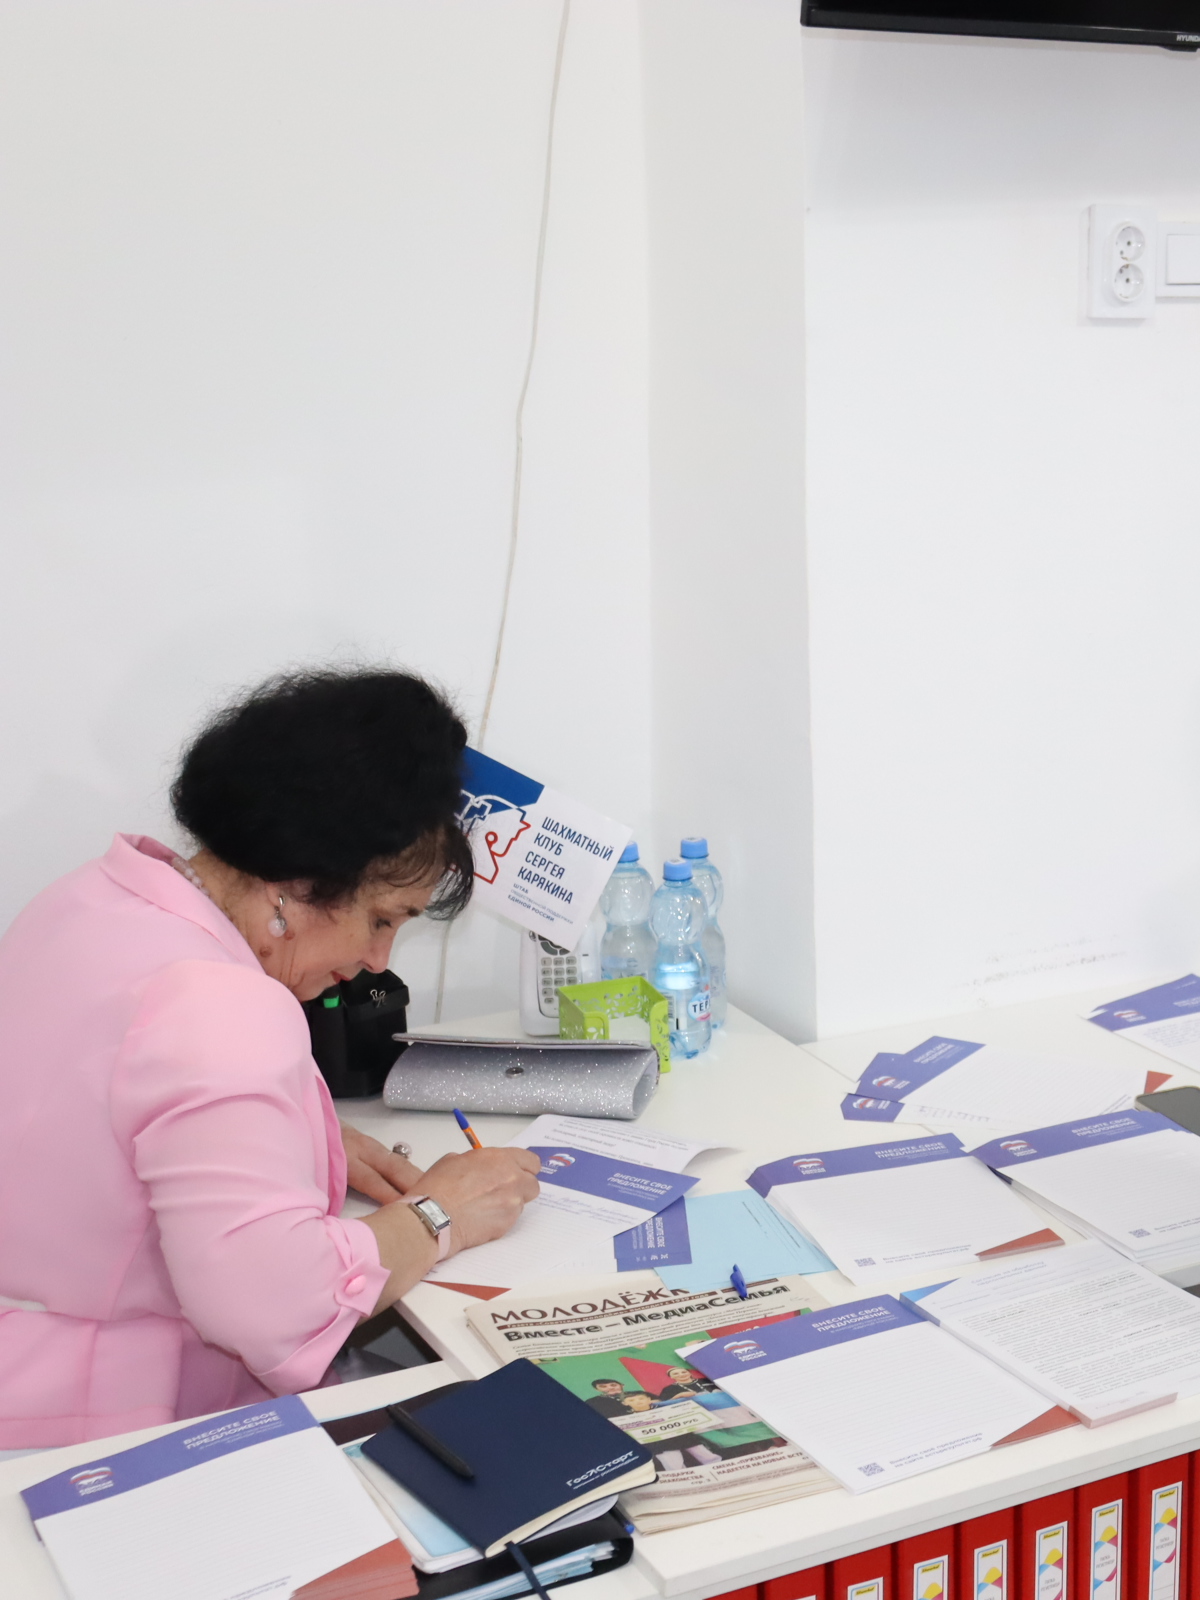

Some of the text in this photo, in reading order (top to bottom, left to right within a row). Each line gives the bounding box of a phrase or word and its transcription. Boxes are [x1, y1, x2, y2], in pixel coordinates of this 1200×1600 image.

[534, 832, 564, 856] КЛУБ
[541, 816, 614, 861] ШАХМАТНЫЙ
[525, 850, 566, 880] СЕРГЕЯ
[513, 882, 529, 894] ШТАБ
[517, 865, 574, 904] КАРЯКИНА
[531, 907, 555, 922] РОССИИ
[607, 1176, 667, 1195] ПРЕДЛОЖЕНИЕ
[613, 1172, 673, 1191] ВНЕСИТЕ СВОЕ
[503, 1323, 602, 1342] Вместе
[622, 1285, 791, 1326] МедиаСемья
[811, 1312, 858, 1329] ВНЕСИТЕ
[858, 1306, 886, 1316] СВОЕ
[816, 1310, 891, 1333] ПРЕДЛОЖЕНИЕ
[183, 1410, 277, 1445] ВНЕСИТЕ СВОЕ
[186, 1415, 281, 1450] ПРЕДЛОЖЕНИЕ
[659, 1421, 681, 1431] 000
